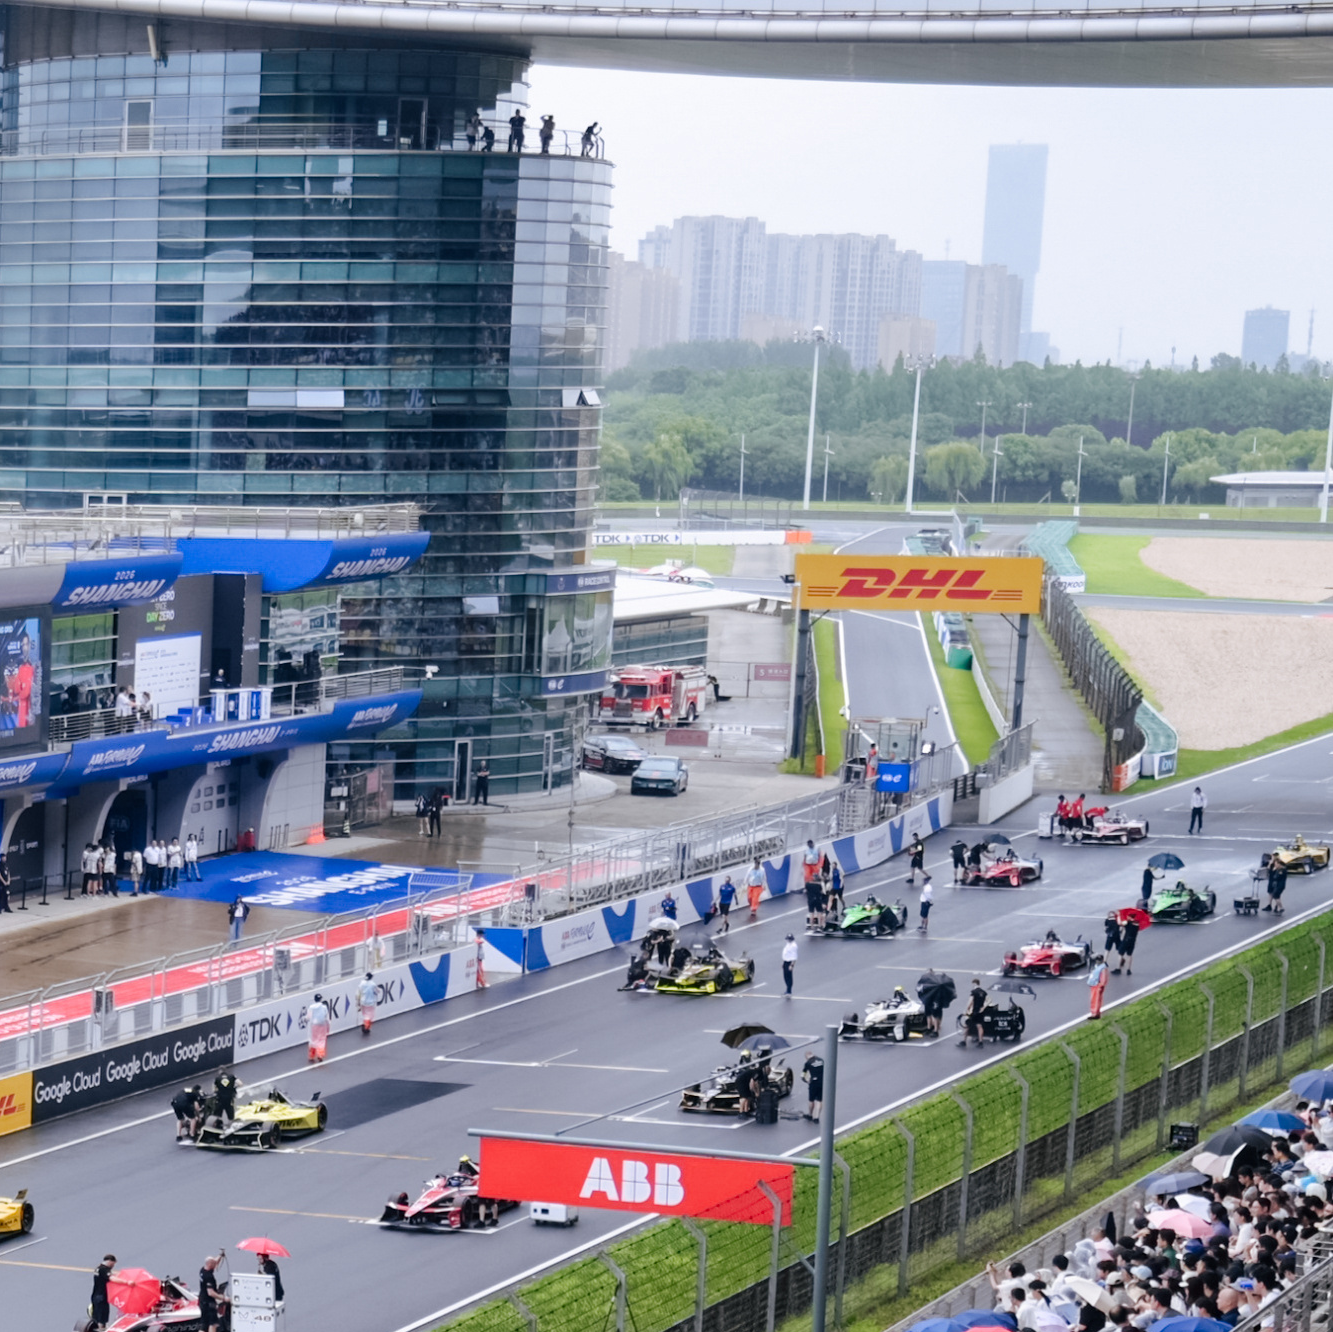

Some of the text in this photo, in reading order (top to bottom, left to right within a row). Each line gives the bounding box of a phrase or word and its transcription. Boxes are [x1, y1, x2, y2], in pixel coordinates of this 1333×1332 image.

[642, 534, 670, 543] TDK
[325, 556, 410, 579] SHANGHAI
[62, 579, 166, 606] SHANGHAI
[836, 568, 992, 600] DHL
[207, 725, 282, 753] SHANGHAI
[173, 1028, 233, 1062] Google Cloud
[248, 1013, 281, 1045] TDK
[106, 1046, 168, 1082] Google Cloud
[35, 1065, 100, 1104] Google Cloud
[580, 1157, 684, 1207] ABB
